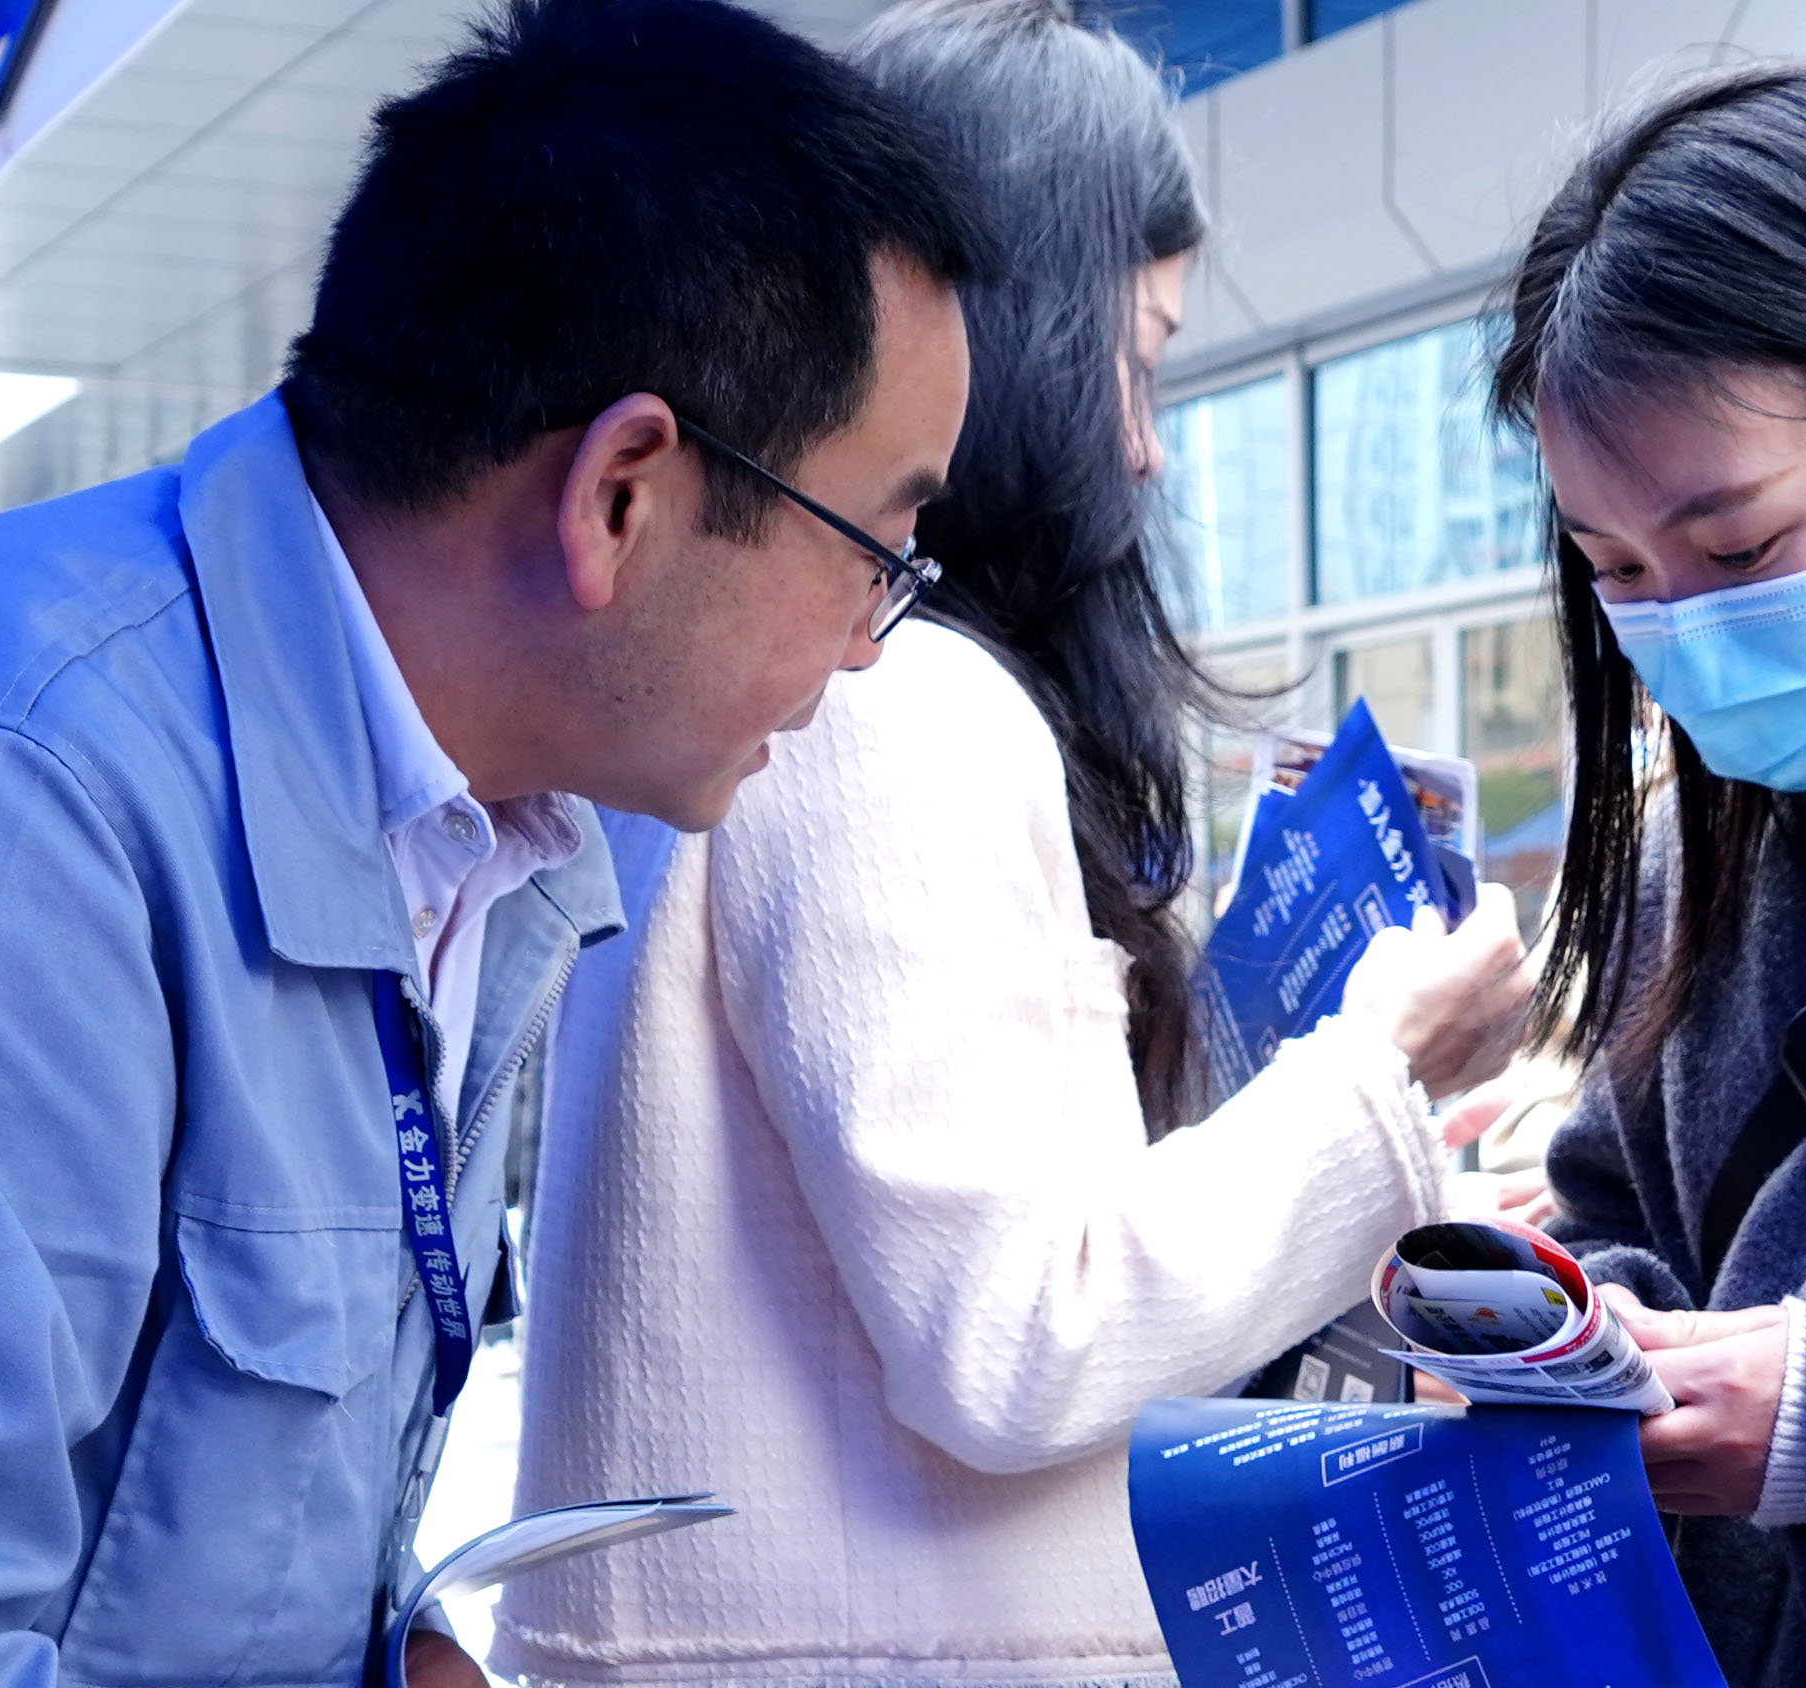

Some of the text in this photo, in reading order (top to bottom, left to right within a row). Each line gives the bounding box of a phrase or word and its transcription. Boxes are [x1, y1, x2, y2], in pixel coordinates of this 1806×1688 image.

[397, 1123, 467, 1343] 金力变速 传动世界
[1184, 1559, 1263, 1611] 大量招聘
[1566, 1570, 1606, 1595] 技术岗
[1213, 1600, 1256, 1636] 普工
[1448, 1615, 1491, 1642] 品质岗
[1352, 1655, 1394, 1682] 营销中心
